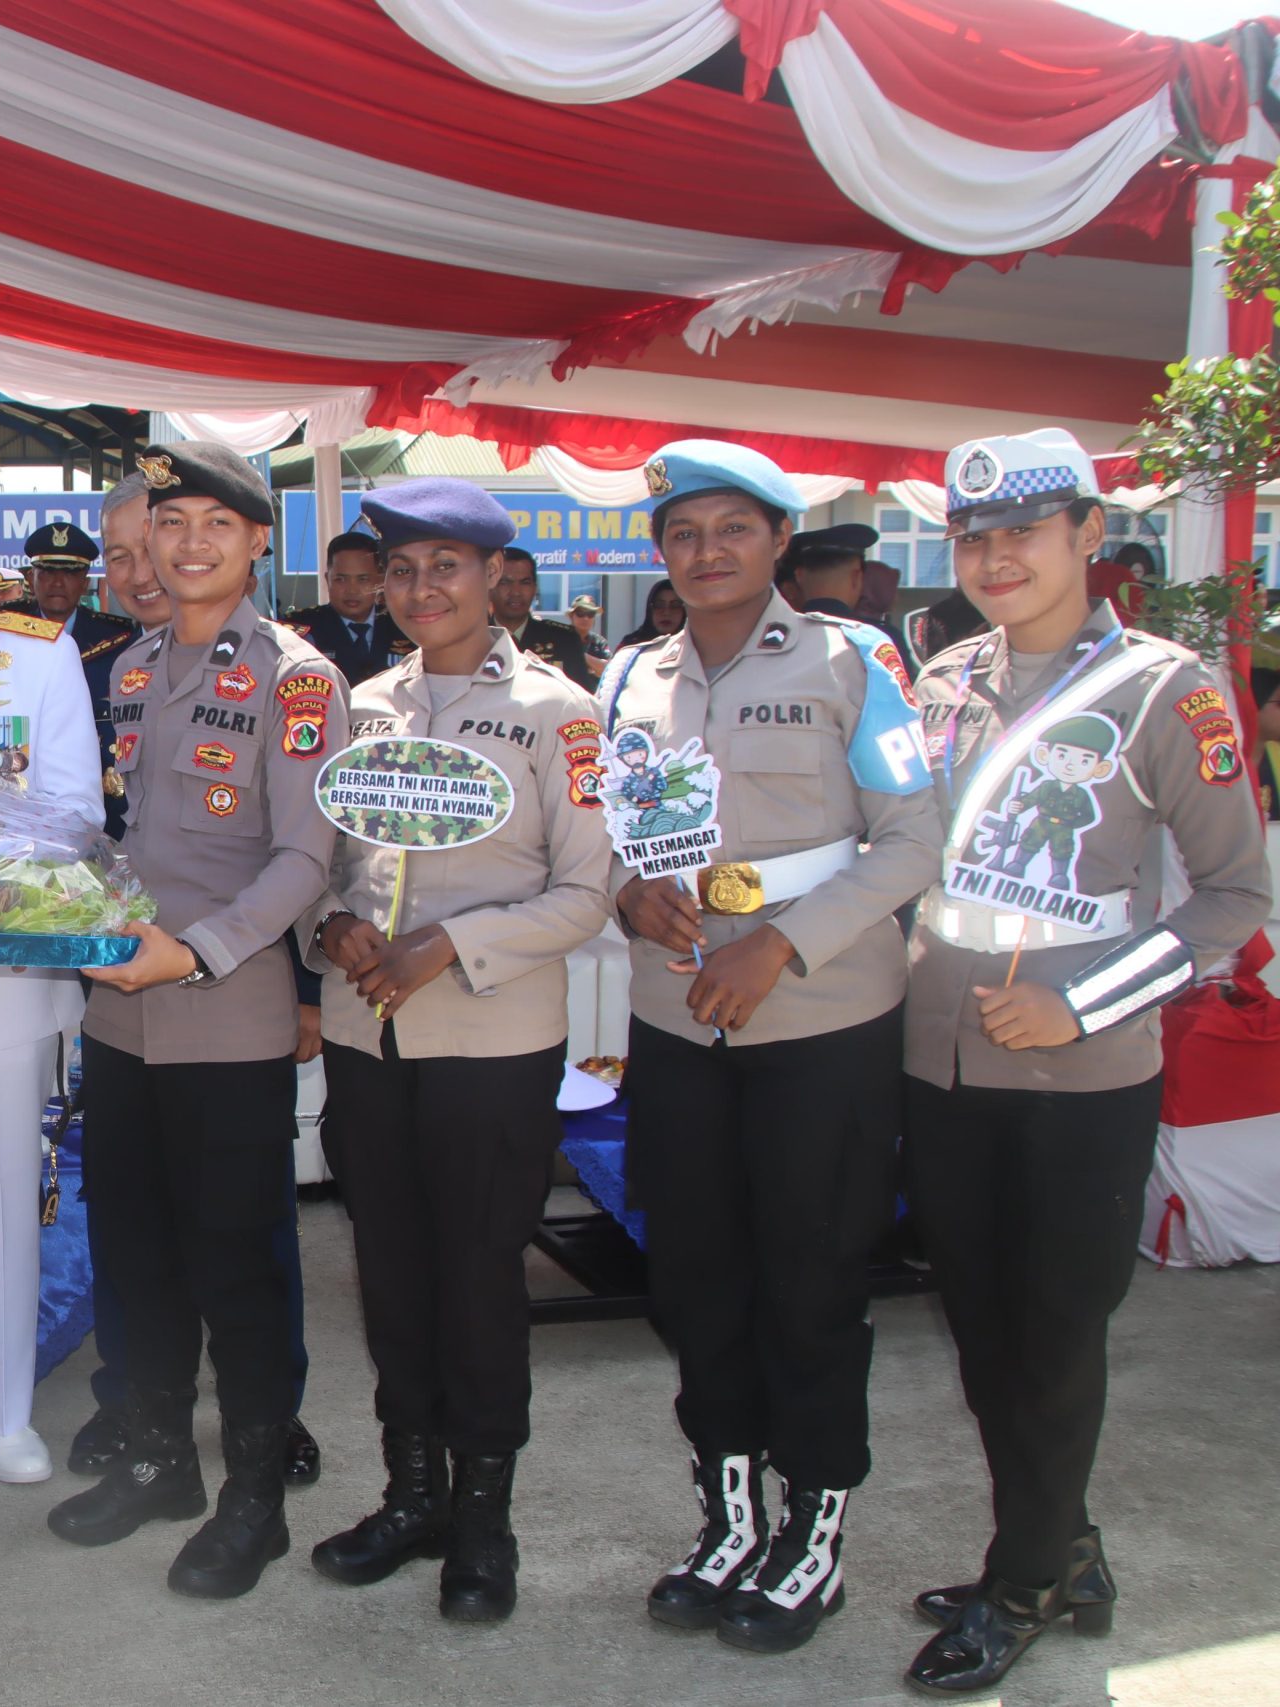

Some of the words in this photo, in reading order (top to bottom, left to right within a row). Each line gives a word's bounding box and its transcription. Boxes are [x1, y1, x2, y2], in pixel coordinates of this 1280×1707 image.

[533, 549, 567, 567] gratif
[586, 550, 636, 565] Modern
[279, 677, 330, 695] POLRES
[283, 685, 328, 699] MERAUKE
[289, 701, 323, 711] PAPUA
[739, 704, 812, 725] POLRI
[191, 704, 257, 736] POLRI
[459, 719, 536, 749] POLRI
[338, 771, 396, 789] BERSAMA
[398, 775, 418, 791] TNI
[420, 777, 448, 793] KITA
[450, 779, 489, 798] AMAN,
[330, 790, 386, 808] BERSAMA
[389, 794, 409, 809] TNI
[411, 796, 439, 812] KITA
[441, 798, 494, 817] NYAMAN
[622, 843, 649, 862] TNI
[650, 829, 718, 857] SEMANGAT
[641, 850, 708, 876] MEMBARA
[951, 866, 992, 896] TNI
[991, 878, 1099, 926] IDOLAKU
